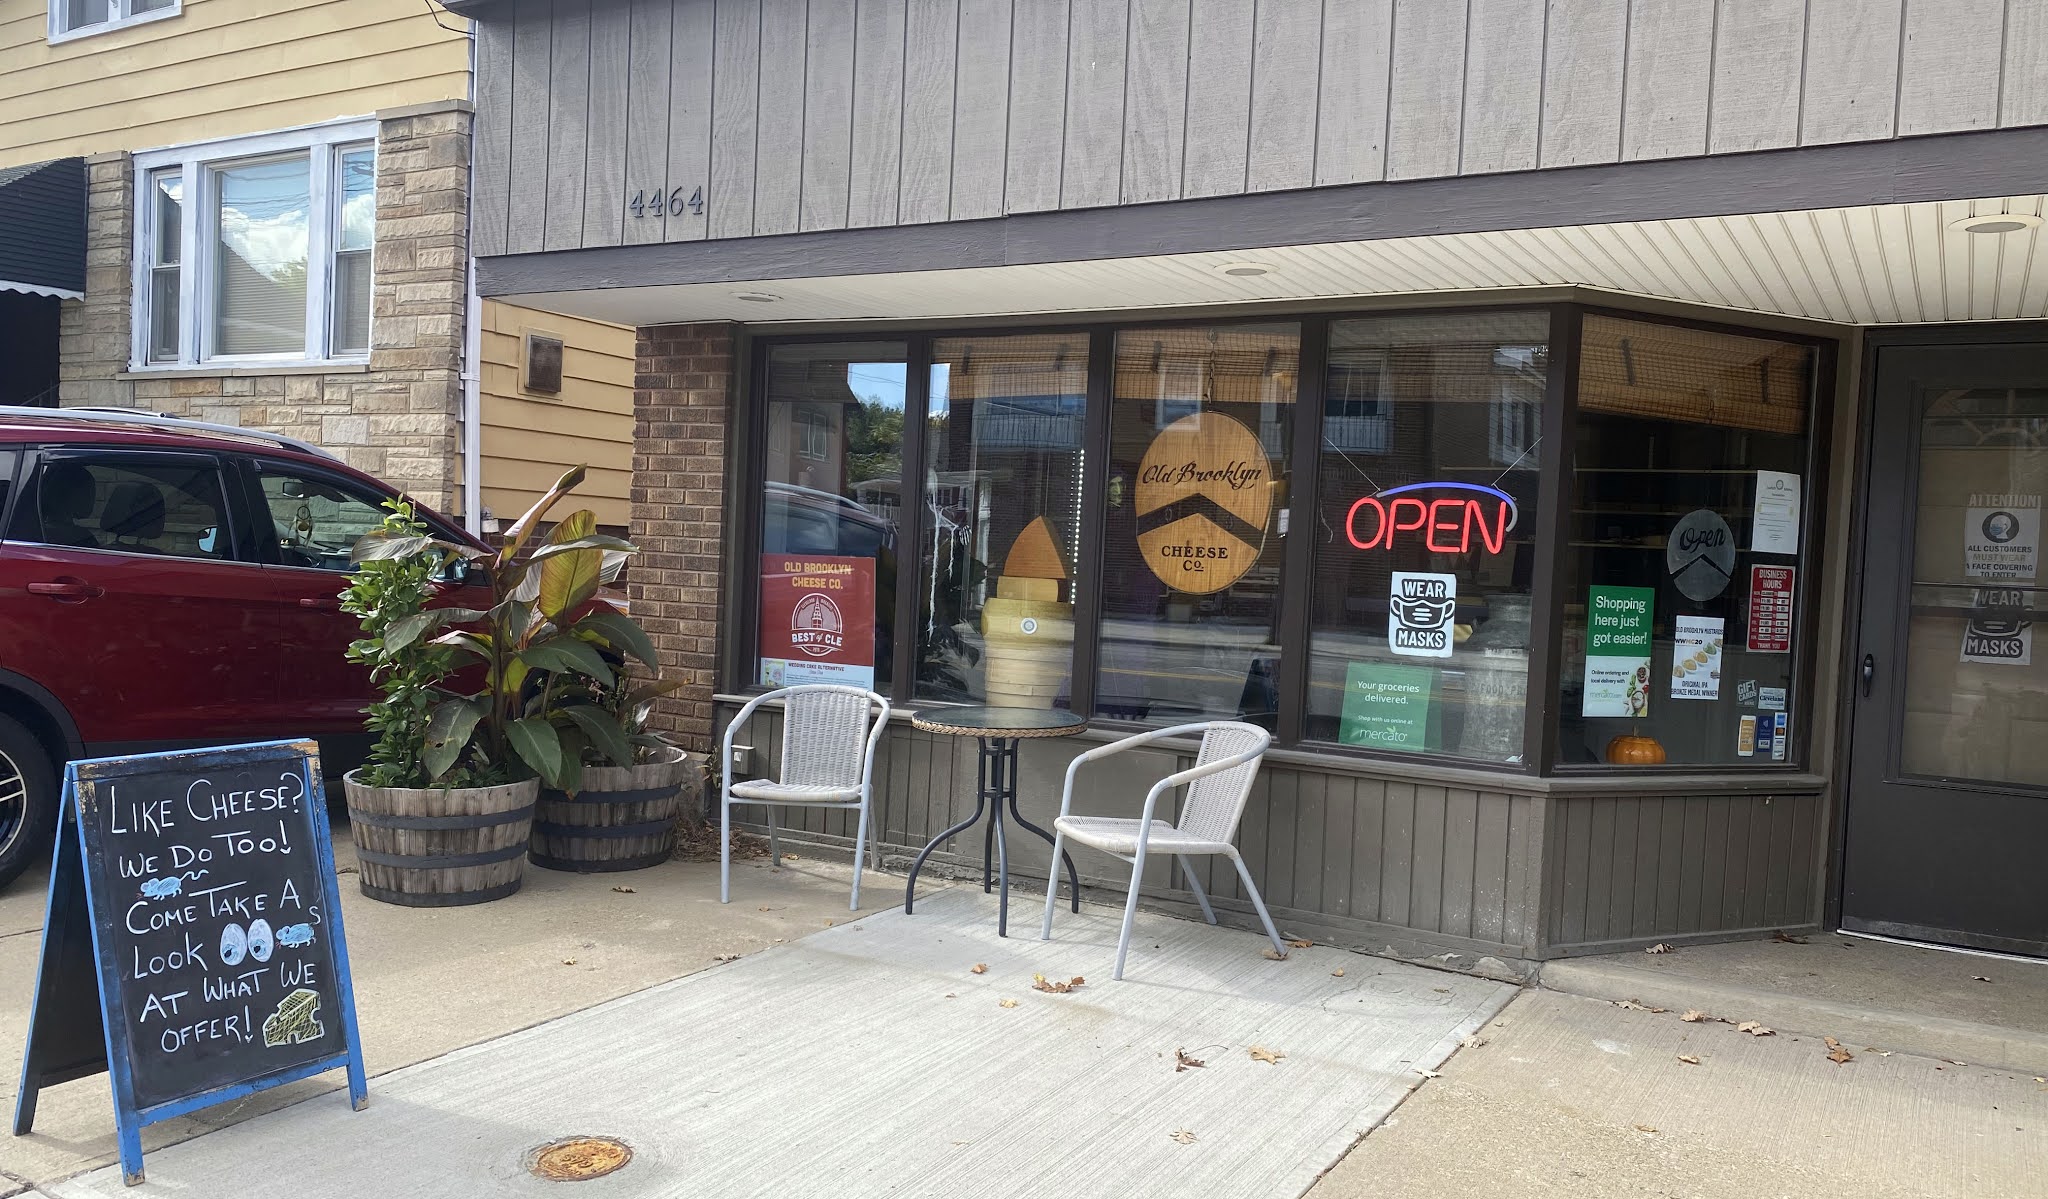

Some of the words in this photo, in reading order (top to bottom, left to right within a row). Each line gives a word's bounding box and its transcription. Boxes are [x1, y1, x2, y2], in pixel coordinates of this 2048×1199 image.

[629, 185, 703, 218] 4464
[1142, 465, 1176, 484] Old
[1174, 460, 1262, 490] Brooklyn
[1346, 497, 1507, 554] OPEN
[1680, 528, 1726, 553] Open
[1161, 546, 1228, 559] CHEESE
[1983, 545, 2032, 553] CUSTOMERS
[784, 562, 801, 572] OLD
[804, 563, 851, 574] BROOKLYN
[1759, 570, 1787, 579] BUSINESS
[792, 577, 826, 588] CHEESE
[828, 578, 843, 589] CO.
[1404, 581, 1446, 597] WEAR
[1763, 580, 1782, 589] HOURS
[1595, 595, 1646, 614] Shopping
[1595, 614, 1617, 626] here
[1619, 615, 1639, 630] just
[792, 633, 815, 643] BEST
[815, 633, 823, 643] of
[825, 634, 842, 647] CLE
[1398, 629, 1444, 647] MASKS
[1593, 633, 1611, 647] got
[1613, 631, 1647, 646] easier!
[1967, 639, 2020, 655] MASKS
[1357, 680, 1376, 689] Your
[1378, 683, 1420, 693] groceries
[1738, 680, 1756, 694] GIFT
[1365, 693, 1409, 704] delivered.
[1738, 691, 1757, 701] CARDS
[1360, 729, 1406, 742] mercato
[111, 786, 174, 837] LIKE
[186, 772, 304, 823] CHEESE?
[119, 855, 158, 880] WE
[125, 901, 196, 935] COME
[188, 880, 268, 920] TAKE
[279, 878, 301, 908] A
[139, 992, 188, 1023] AT
[202, 967, 269, 1003] WHAT
[280, 960, 316, 986] WE
[160, 1005, 254, 1053] OFFER!
